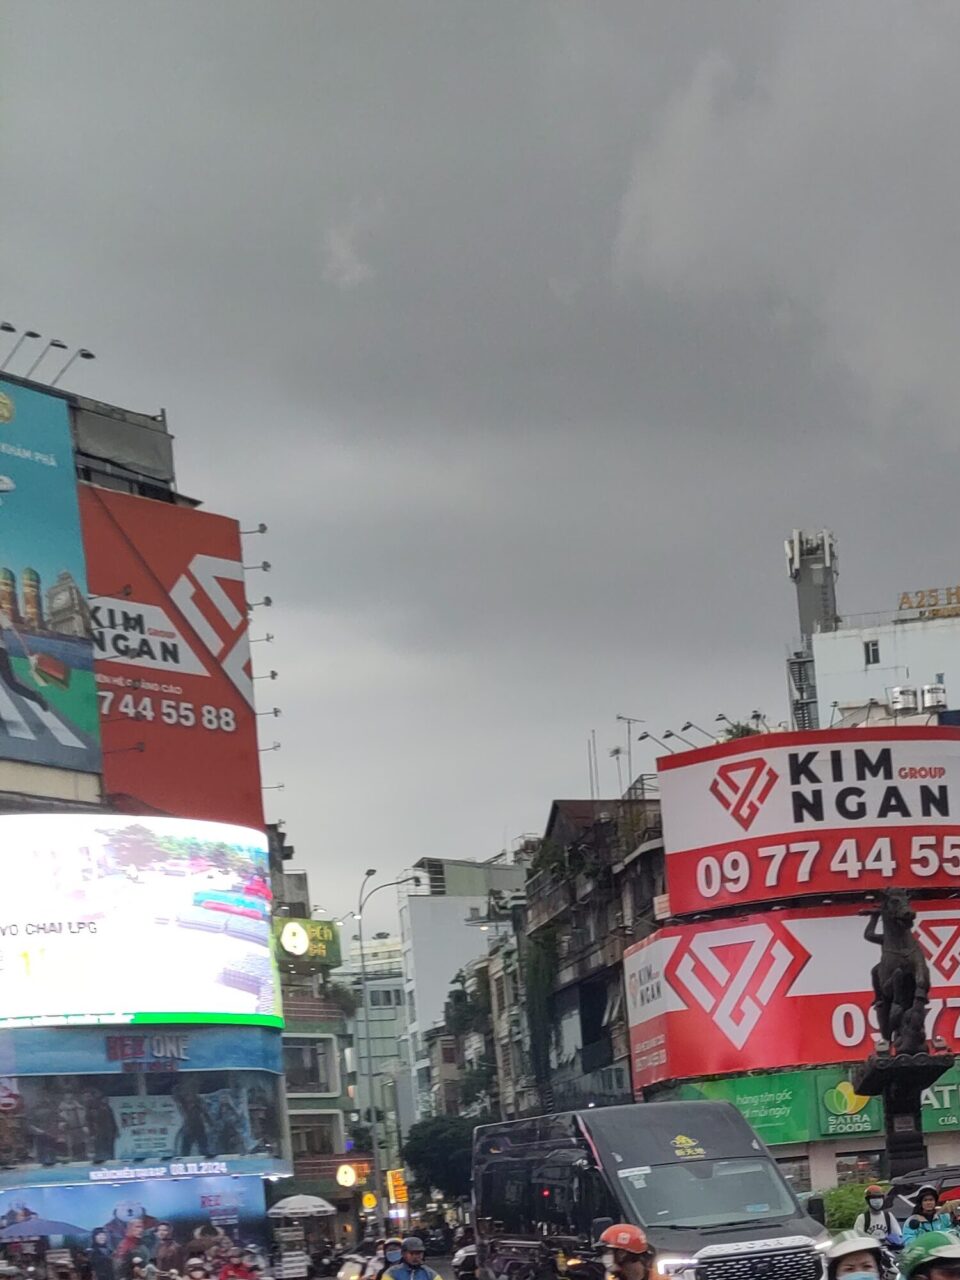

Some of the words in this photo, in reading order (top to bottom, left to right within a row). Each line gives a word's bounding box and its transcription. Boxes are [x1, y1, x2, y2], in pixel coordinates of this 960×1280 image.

[899, 589, 940, 611] A25
[118, 693, 155, 721] 44
[160, 699, 196, 727] 55
[201, 704, 236, 732] 88
[788, 748, 893, 786] KIM
[898, 766, 946, 781] GROUP
[791, 784, 950, 824] NGAN
[697, 850, 750, 898] 09
[758, 841, 820, 888] 77
[830, 837, 896, 879] 44
[828, 1114, 870, 1125] SATRA
[828, 1123, 871, 1134] FOODS
